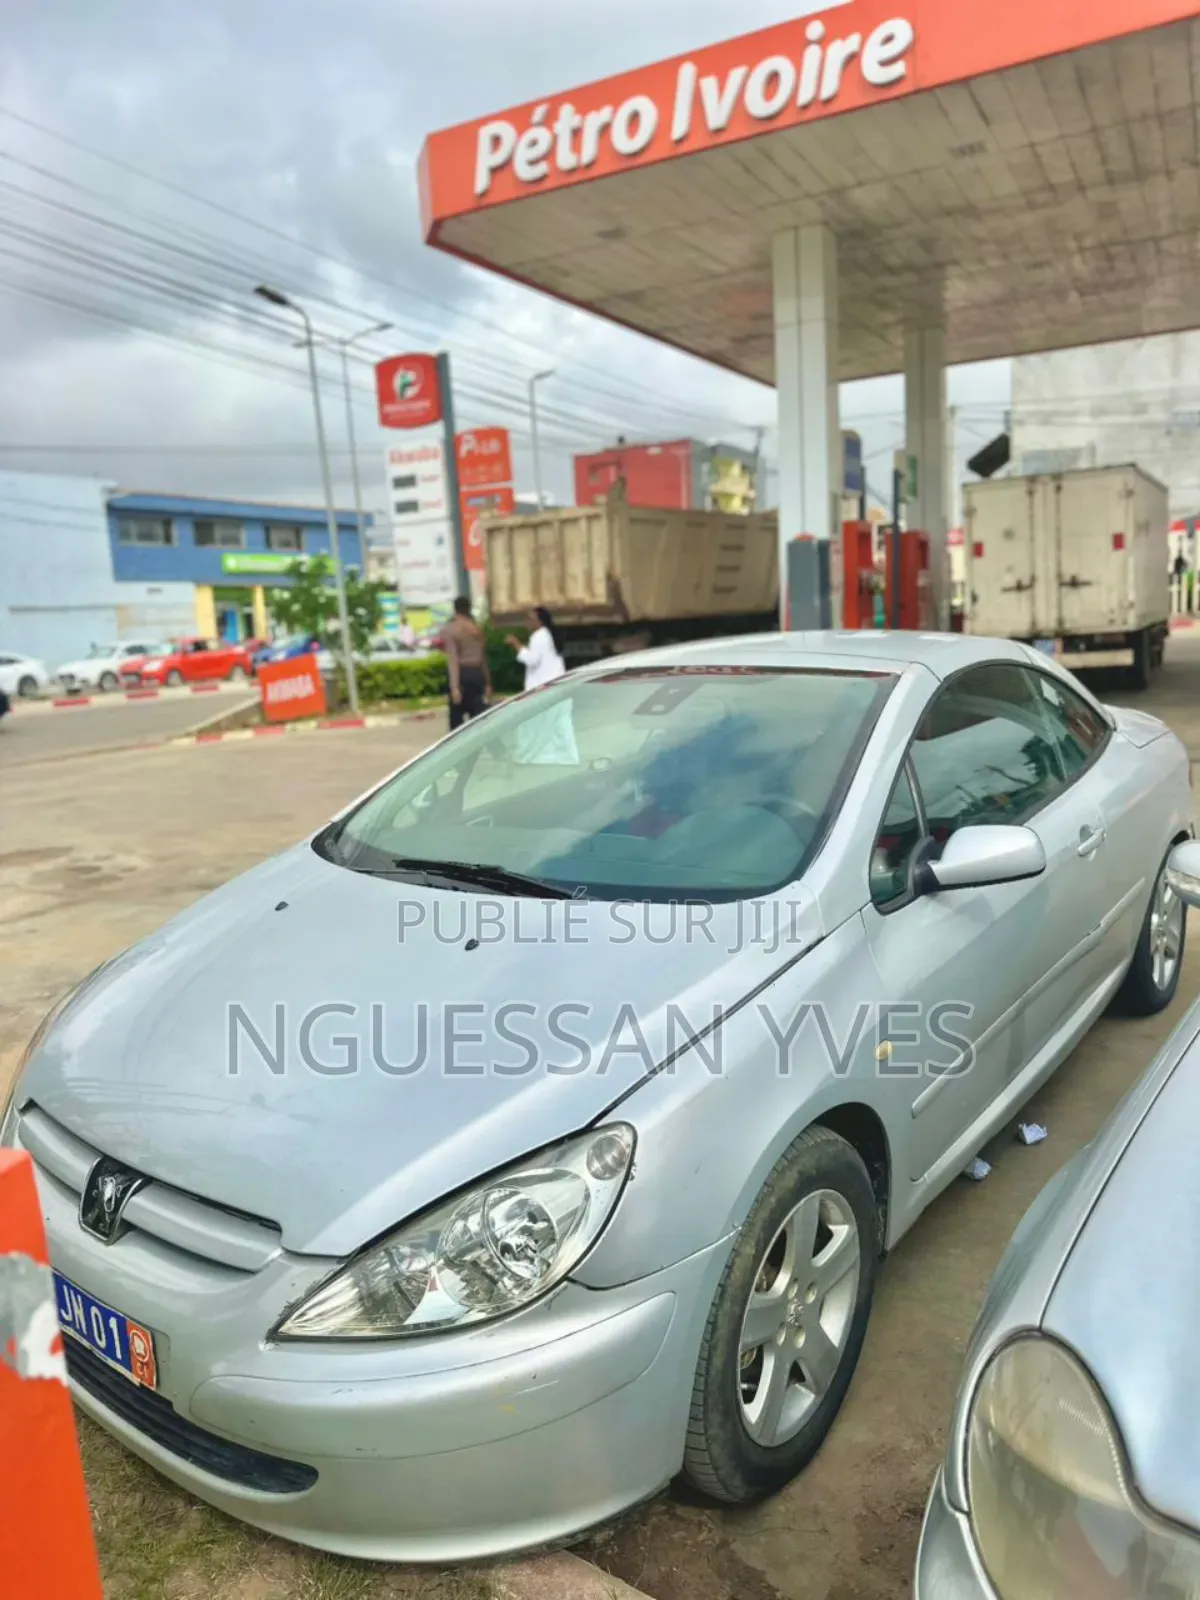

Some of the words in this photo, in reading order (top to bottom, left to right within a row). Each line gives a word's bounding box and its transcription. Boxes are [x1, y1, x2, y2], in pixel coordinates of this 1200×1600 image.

[475, 95, 659, 194] Pétro
[671, 18, 914, 142] Ivoire
[60, 1284, 87, 1335] JN
